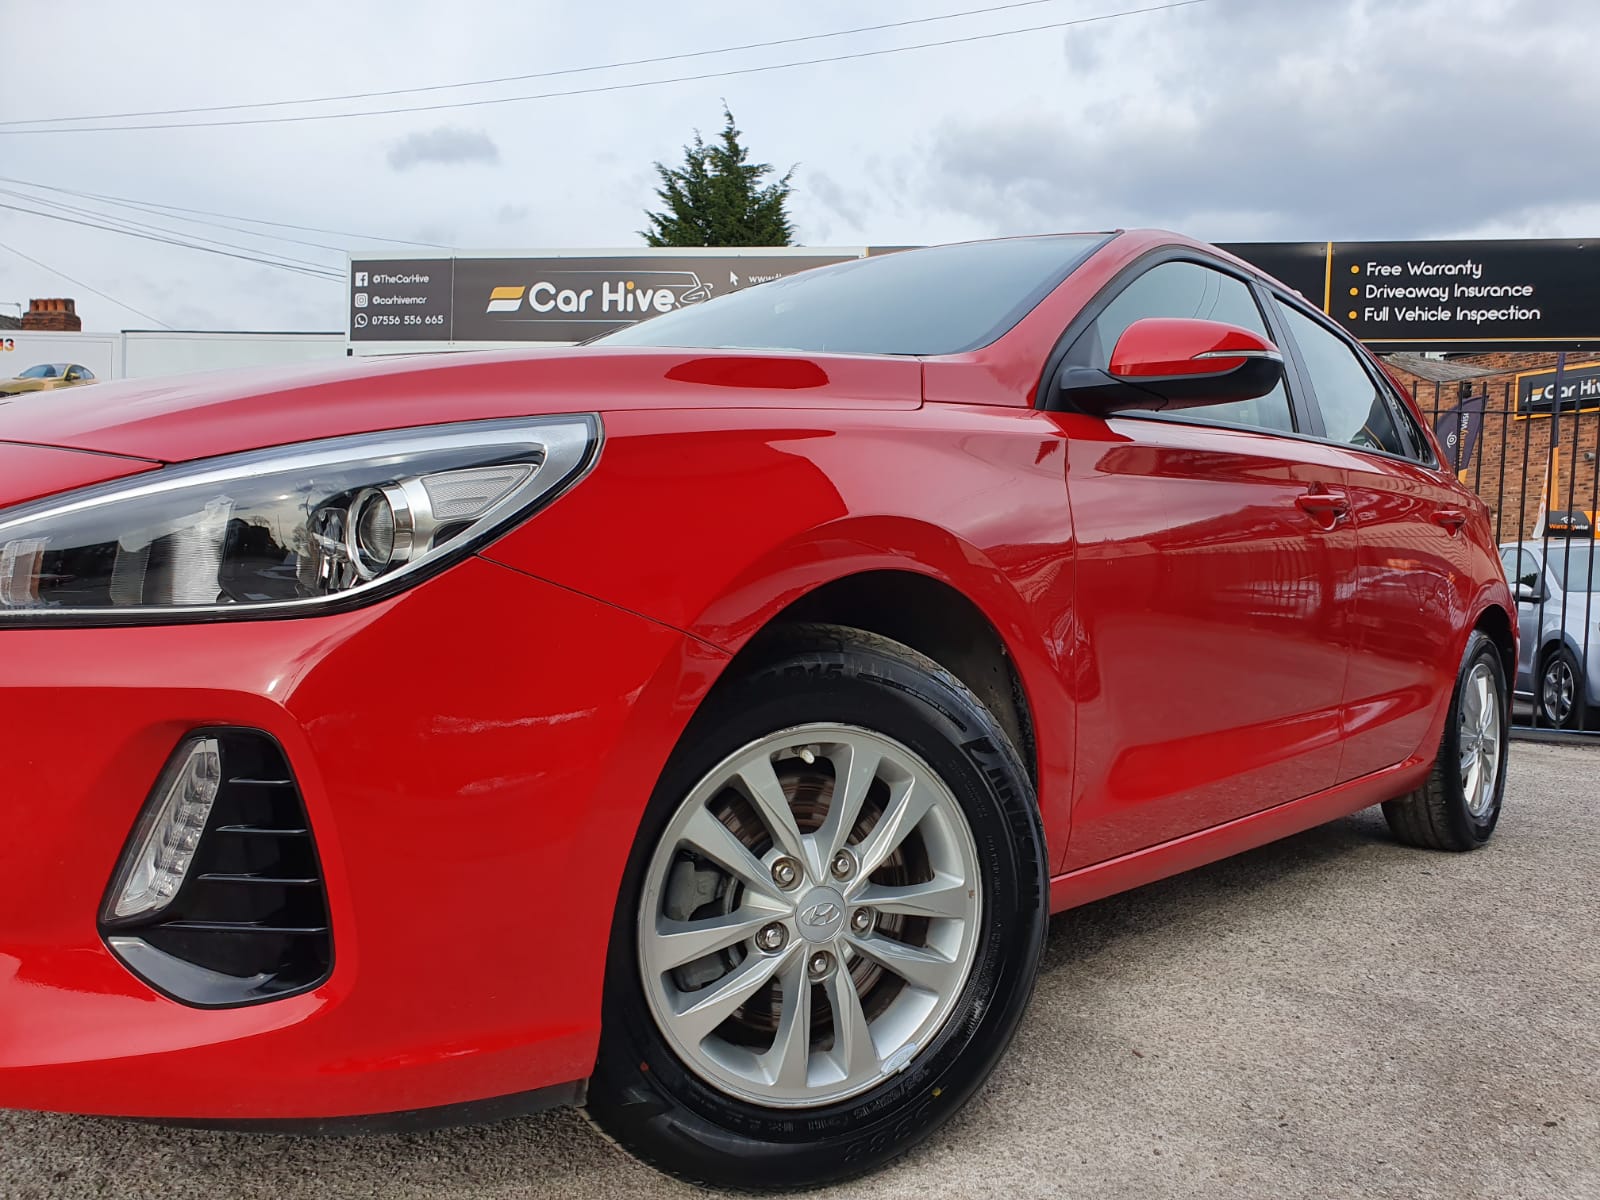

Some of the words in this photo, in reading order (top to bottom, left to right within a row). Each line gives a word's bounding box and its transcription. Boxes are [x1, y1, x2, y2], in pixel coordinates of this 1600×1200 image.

[1366, 262, 1402, 277] Free
[1407, 260, 1483, 279] Warranty
[372, 274, 430, 284] @TheCarHive
[372, 295, 428, 305] @carhivemcr
[528, 281, 594, 313] Car
[601, 280, 676, 313] Hive
[1365, 284, 1449, 302] Driveaway
[1454, 283, 1534, 299] Insurance
[372, 315, 401, 326] 07556
[404, 315, 422, 326] 556
[425, 315, 444, 326] 665
[1364, 307, 1389, 322] Full
[1394, 307, 1451, 322] Vehicle
[1456, 306, 1542, 325] Inspection
[0, 338, 15, 351] 3
